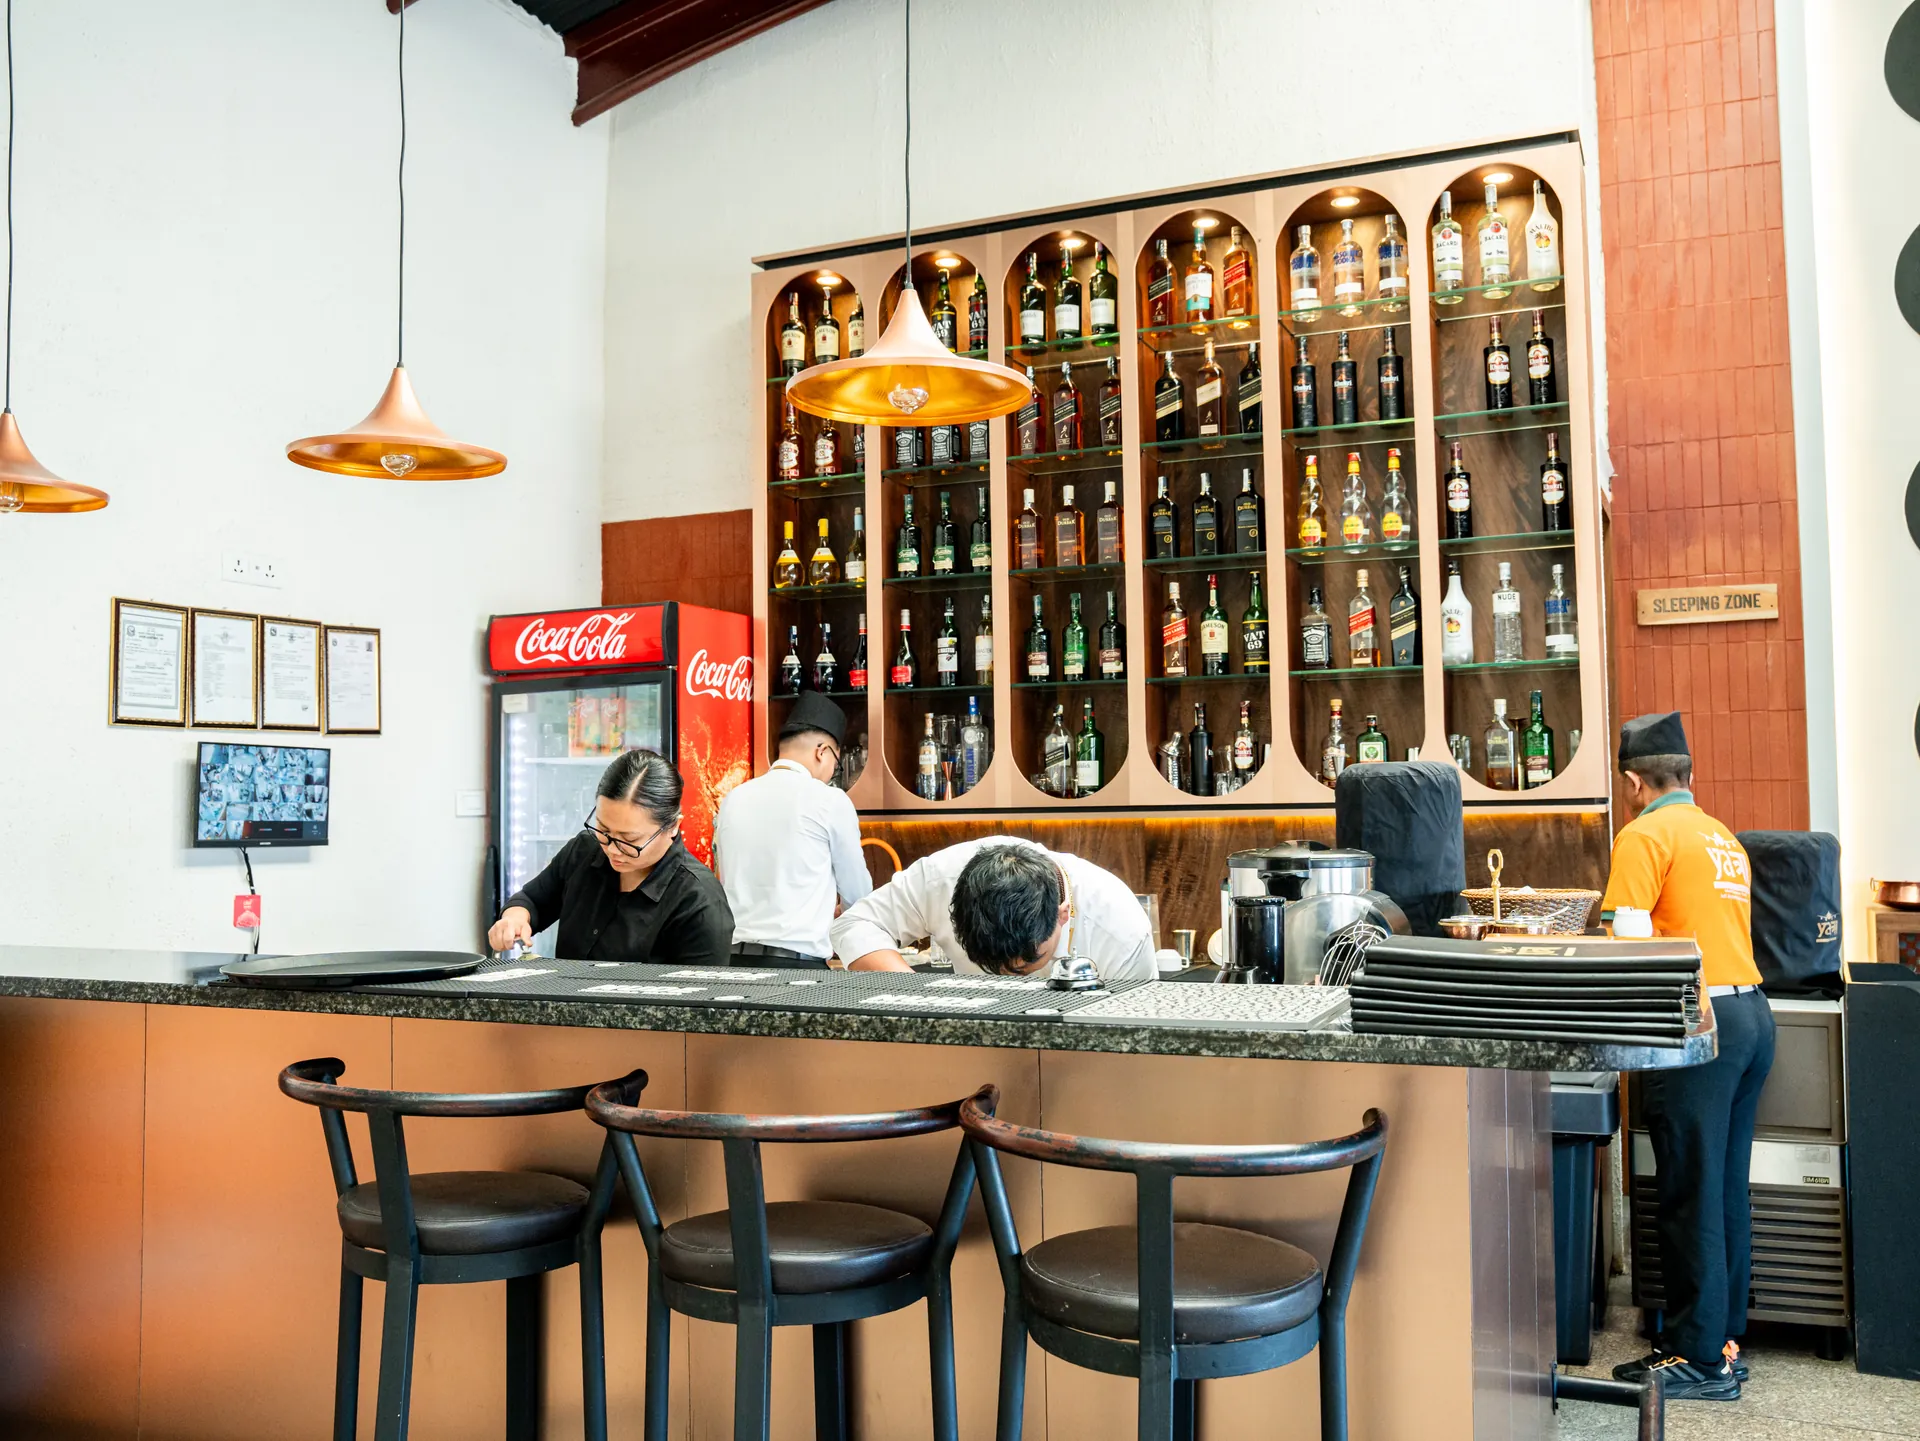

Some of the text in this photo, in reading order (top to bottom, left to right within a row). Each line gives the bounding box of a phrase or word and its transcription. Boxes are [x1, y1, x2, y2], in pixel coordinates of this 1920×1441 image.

[1653, 593, 1761, 613] SLEEPING ZONE
[515, 612, 636, 664] Coca-Cola
[1244, 630, 1265, 642] VAT
[1247, 640, 1262, 650] 69
